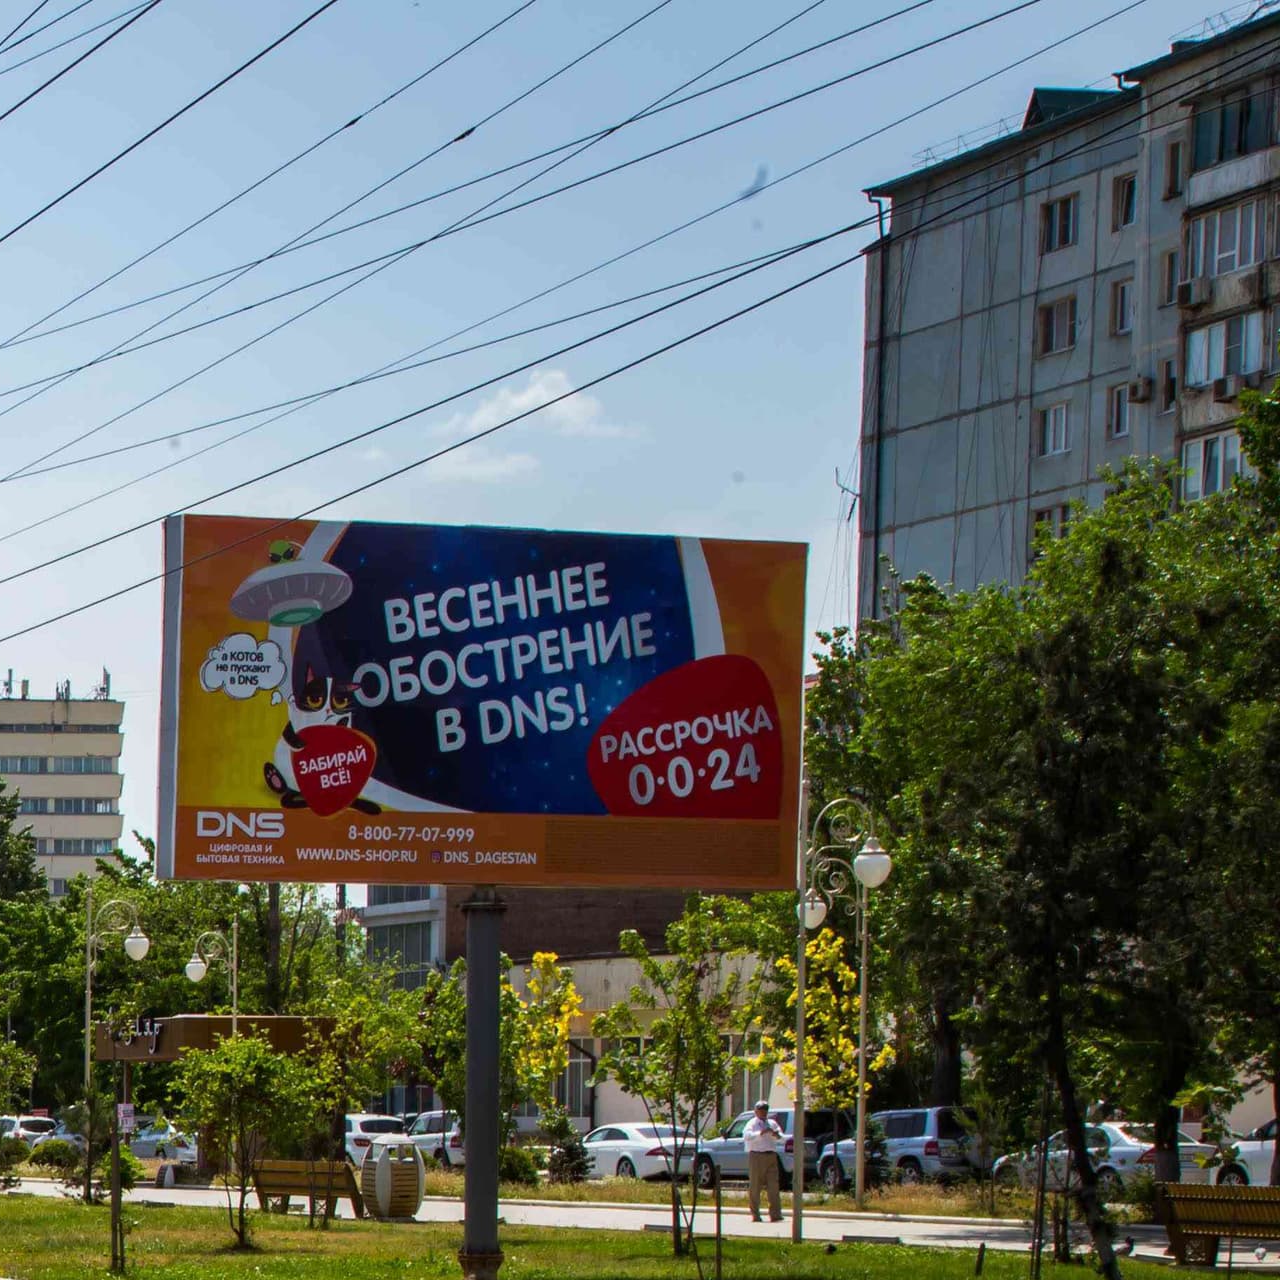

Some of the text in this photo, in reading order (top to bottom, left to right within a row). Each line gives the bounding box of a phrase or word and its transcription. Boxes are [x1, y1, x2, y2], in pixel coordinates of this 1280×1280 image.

[383, 561, 610, 645] ВЕСЕННЕЕ
[221, 650, 264, 663] а КОТОВ
[352, 612, 657, 709] ОБОСТРЕНИЕ
[216, 663, 272, 675] не пускают
[229, 674, 259, 686] в DNS
[436, 683, 589, 753] В DNS!
[599, 704, 774, 764] РАССРОЧКА
[299, 744, 367, 775] ЗАБИРАЙ
[320, 770, 352, 789] ВСЁ!
[196, 811, 285, 838] DNS
[348, 825, 475, 843] 8-800-77-07-999
[209, 843, 273, 854] ЦИФРОВАЯ И
[296, 848, 418, 863] WWW.DNS-SHOP.RU
[196, 853, 285, 865] БЫТОВАЯ ТЕХНИКА
[444, 851, 537, 866] DNS_DAGESTAN
